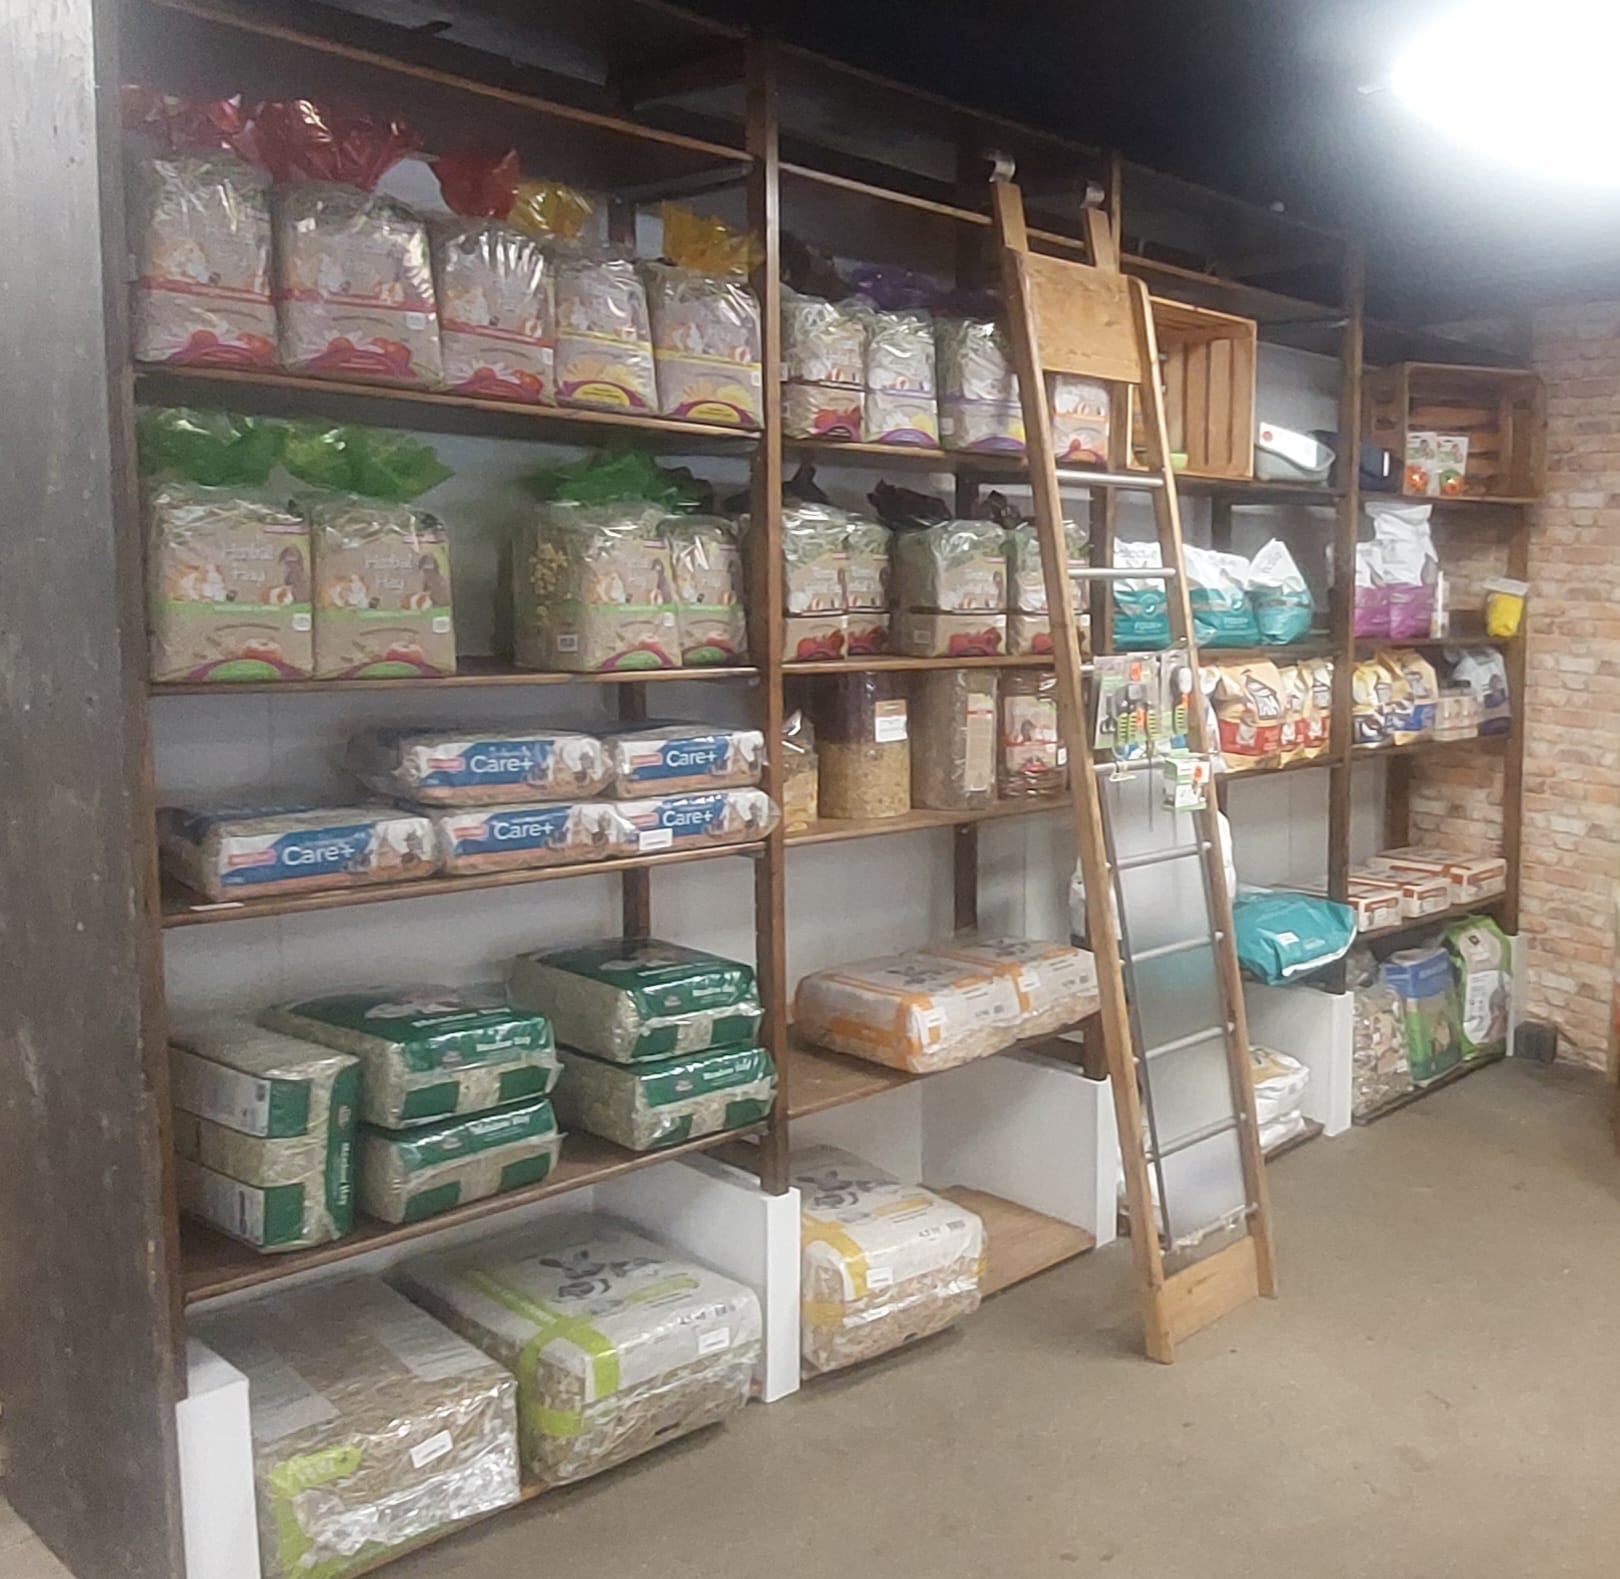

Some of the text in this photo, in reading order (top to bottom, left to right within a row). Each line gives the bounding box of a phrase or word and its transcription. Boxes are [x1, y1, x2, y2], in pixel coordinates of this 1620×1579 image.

[470, 754, 535, 773] Care+
[666, 750, 718, 767] Care+
[663, 809, 714, 827] Care+
[494, 820, 554, 840] Care+
[282, 843, 355, 866] Care+
